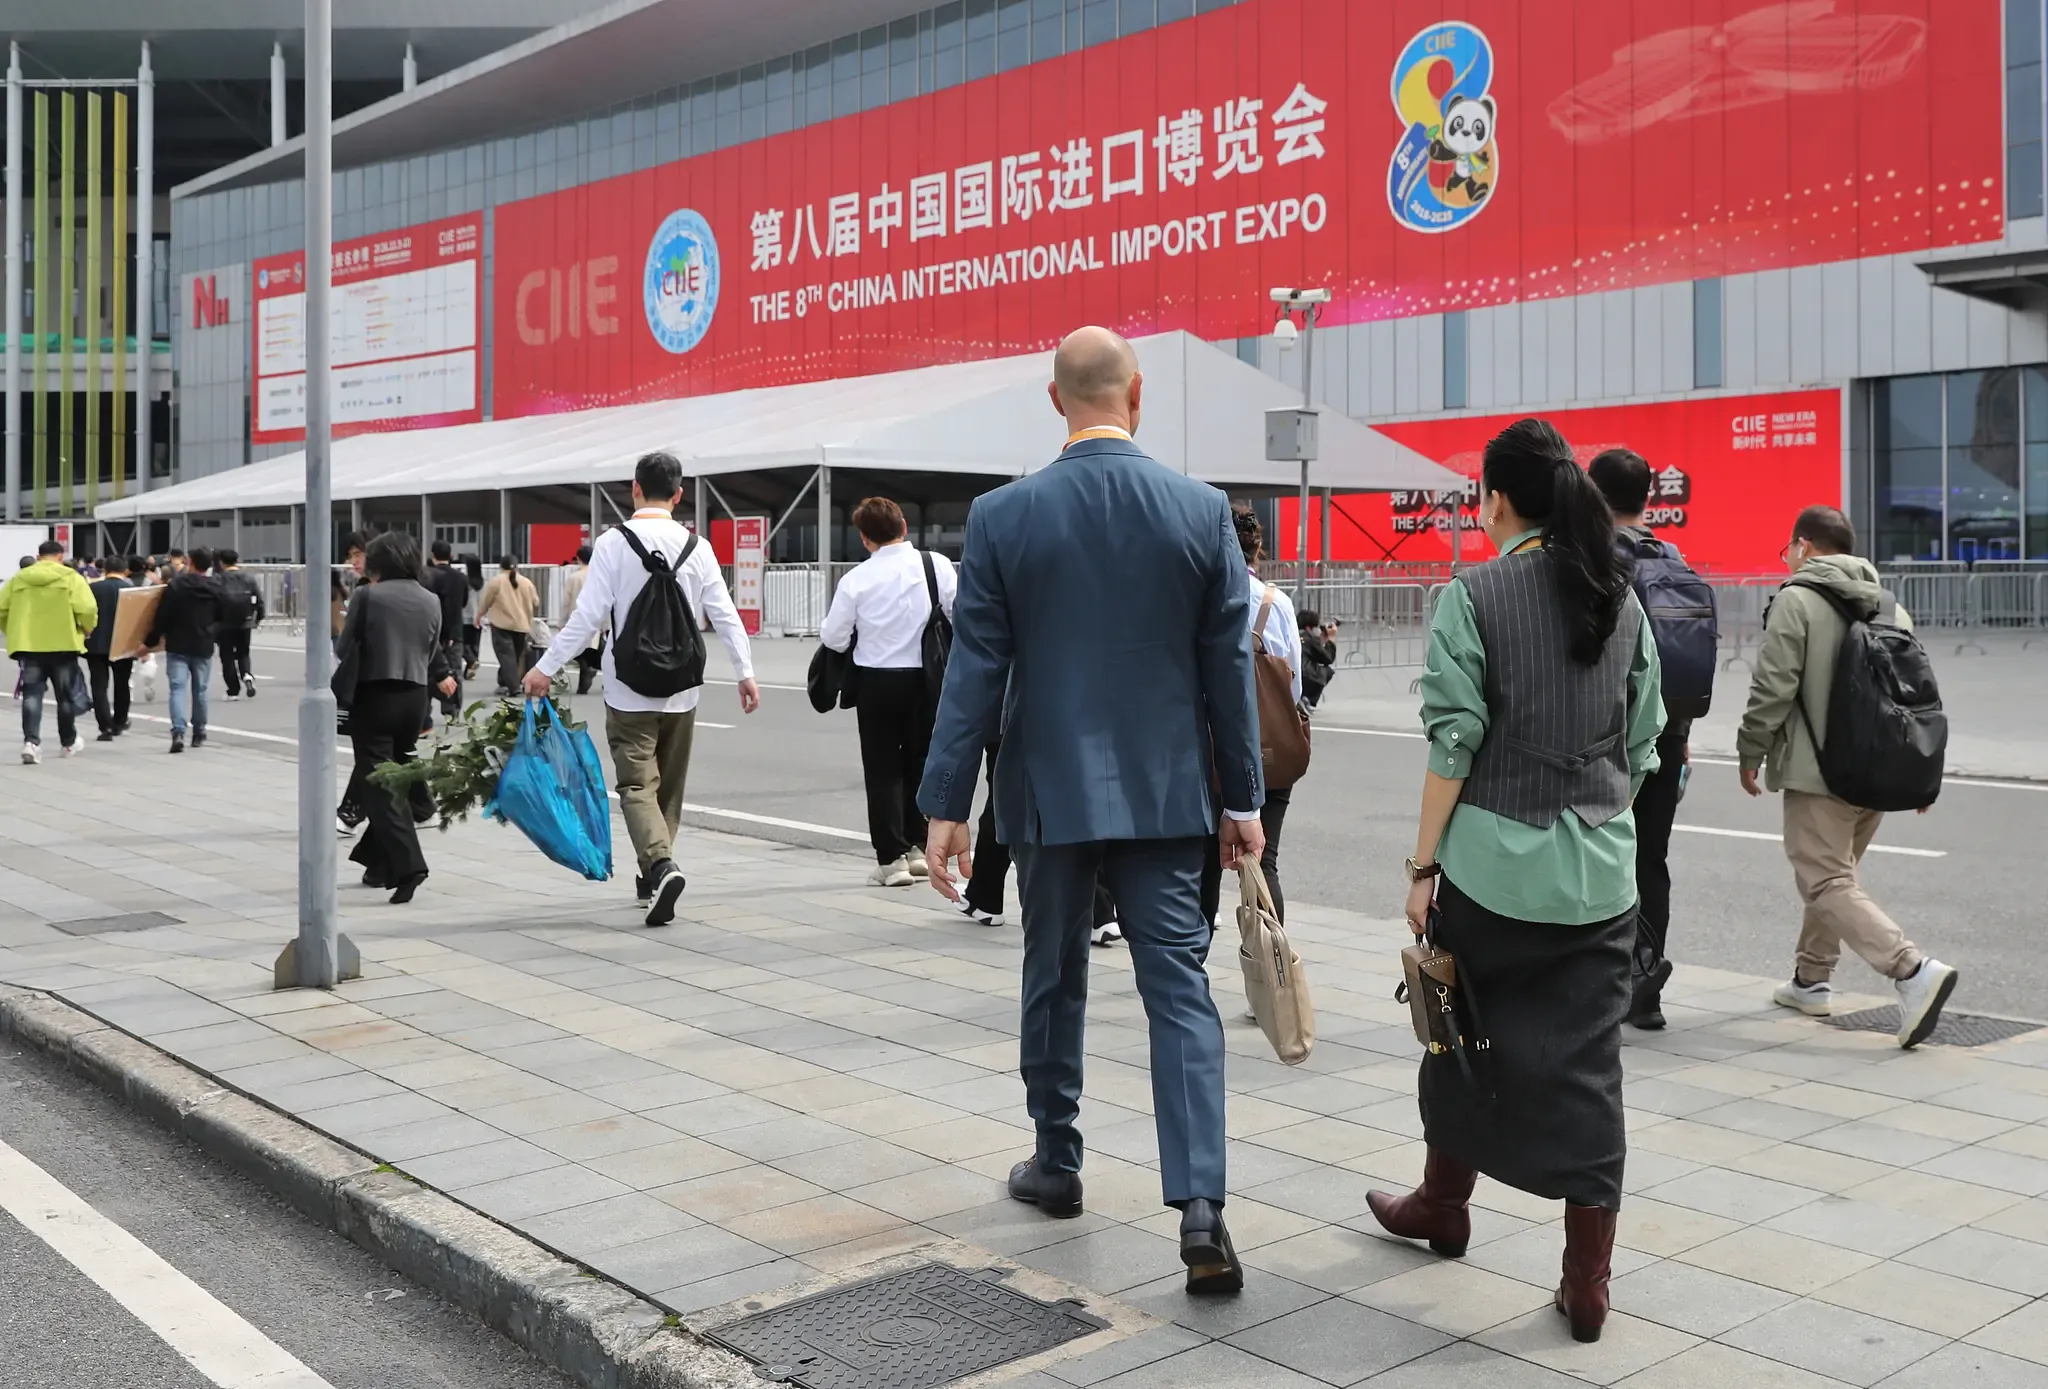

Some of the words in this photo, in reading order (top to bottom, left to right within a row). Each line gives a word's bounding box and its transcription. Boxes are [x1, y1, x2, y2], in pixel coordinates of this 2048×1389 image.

[1424, 30, 1457, 53] CIIE
[750, 82, 1328, 272] 第八届中国国际进口博览会
[750, 291, 790, 324] THE
[795, 284, 823, 318] 8TH
[827, 273, 897, 312] CHINA
[902, 236, 1104, 301] INTERNATIONAL
[1111, 211, 1227, 266] IMPORT
[1235, 193, 1327, 245] EXPO
[663, 266, 700, 296] CIIE
[516, 255, 619, 345] CIIE
[1732, 414, 1767, 433] CIIE
[1392, 516, 1414, 530] THE
[1642, 507, 1683, 523] EXPO
